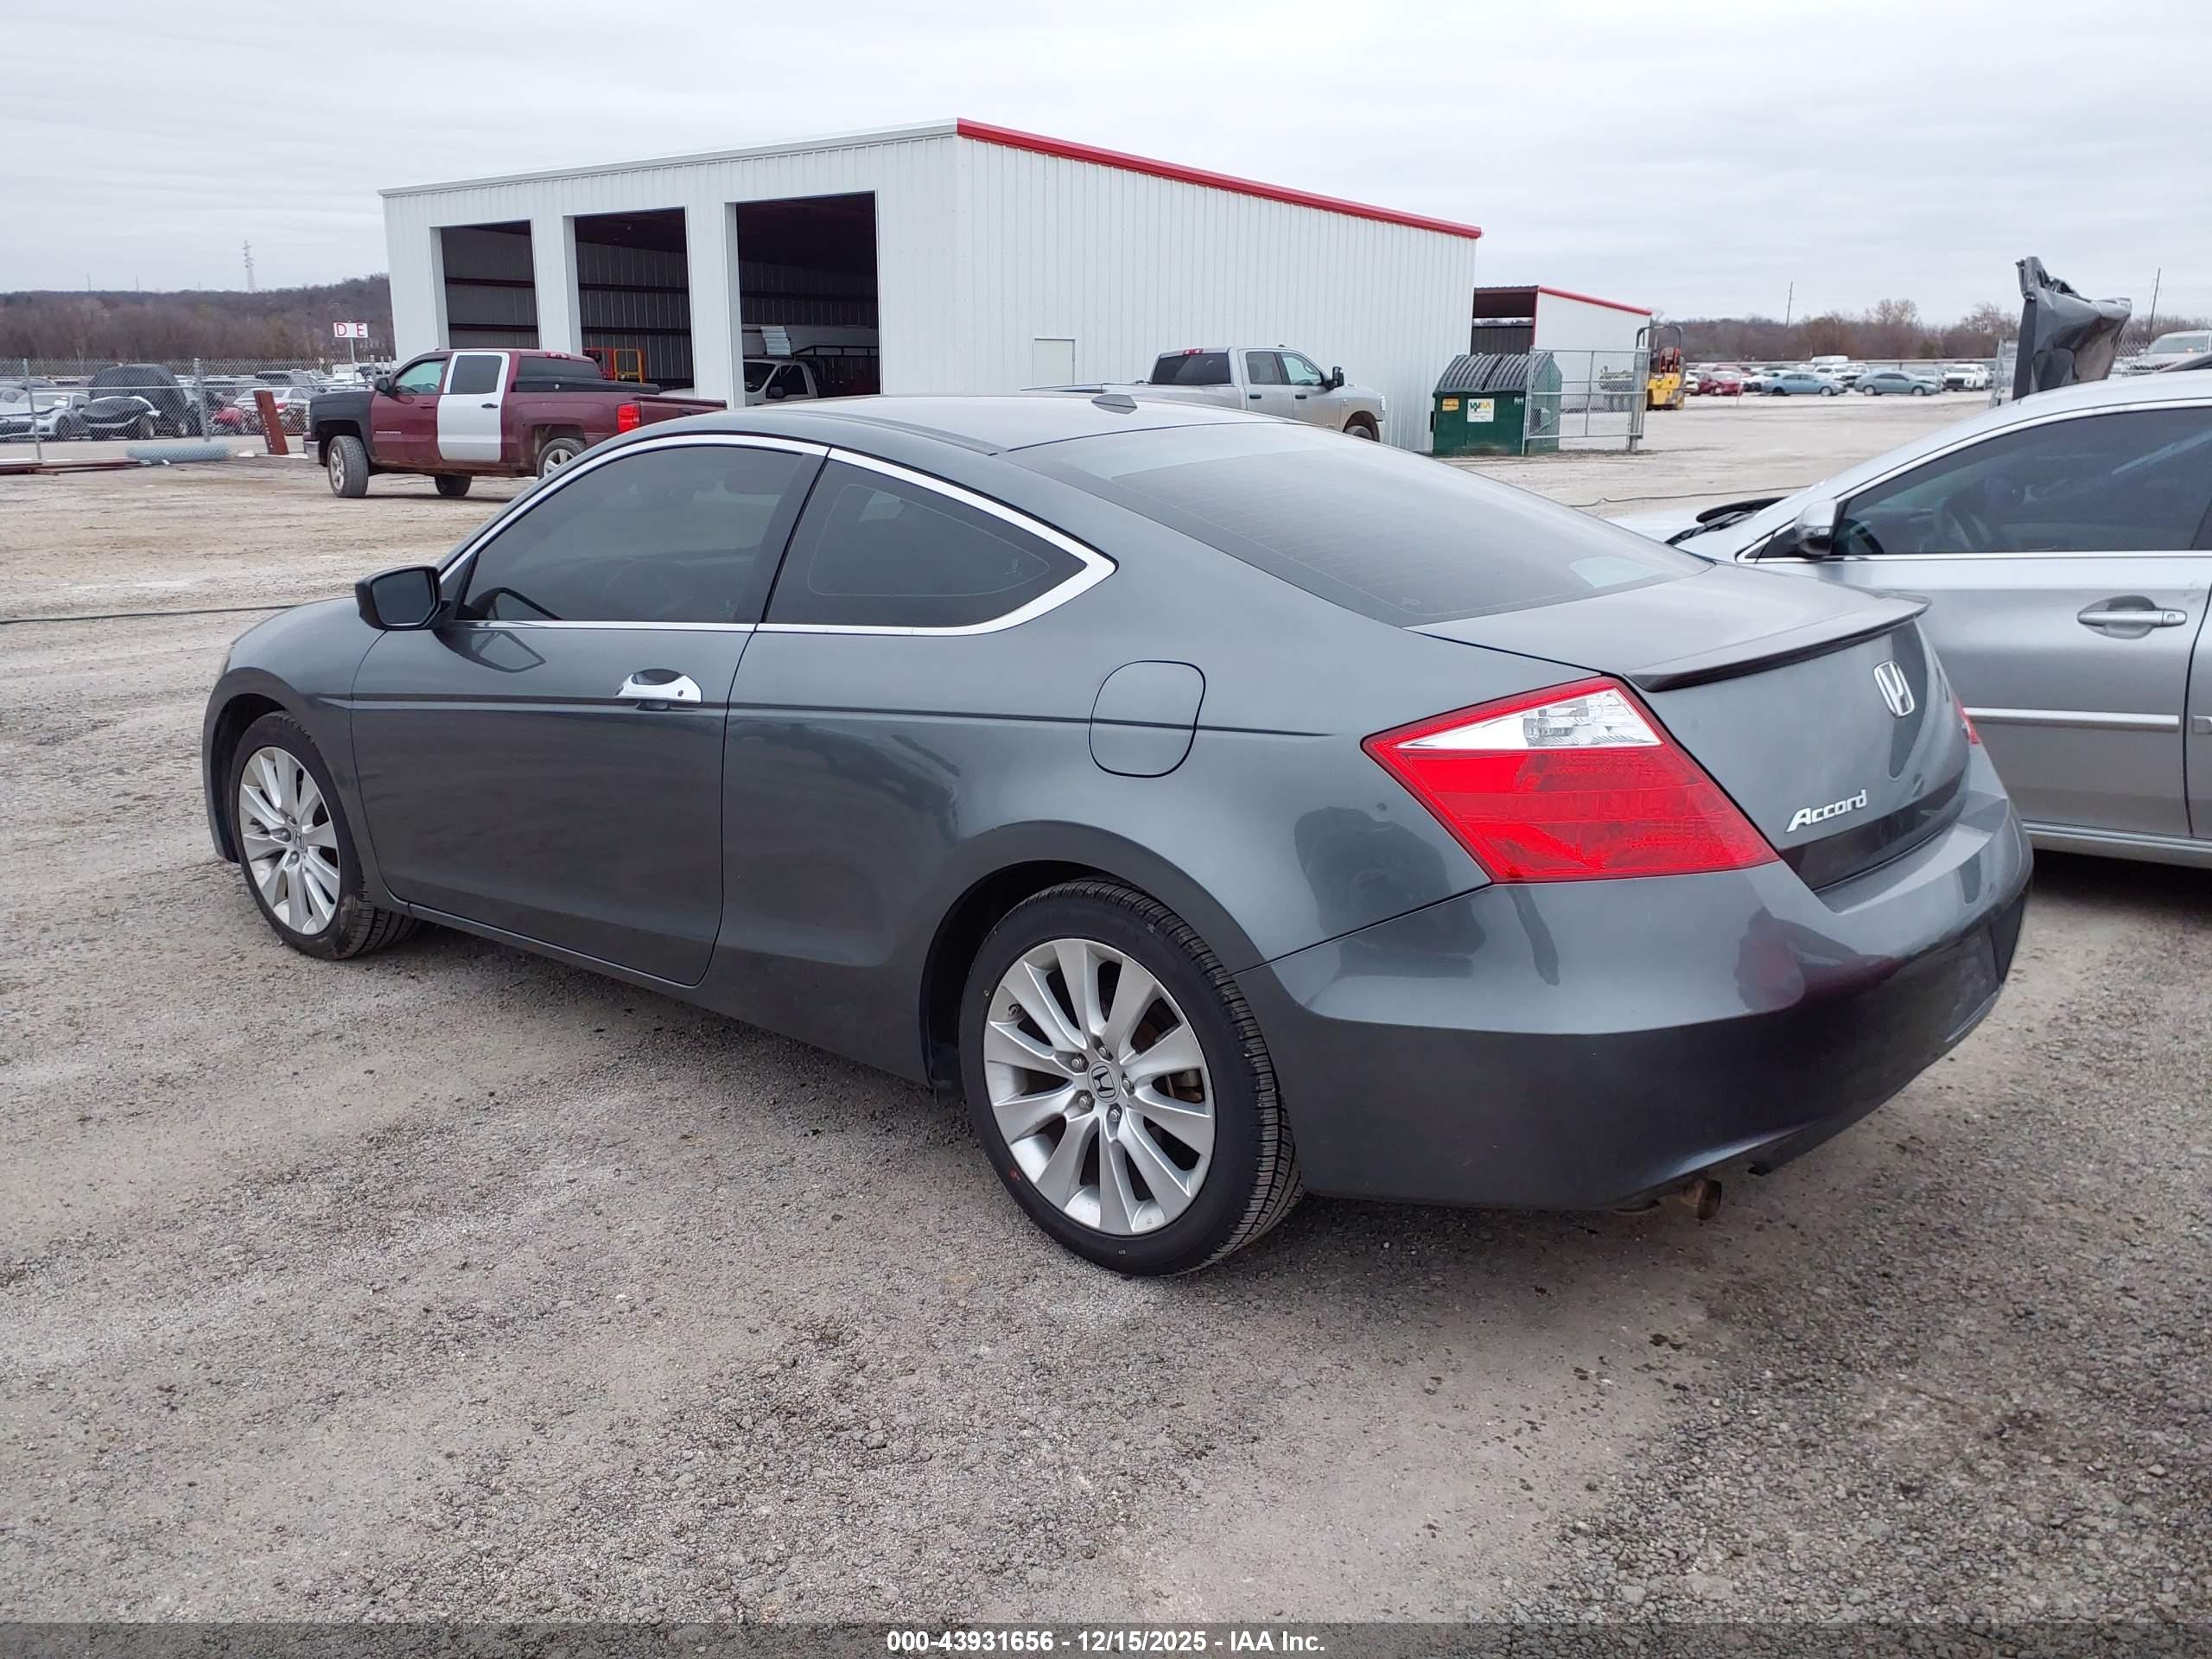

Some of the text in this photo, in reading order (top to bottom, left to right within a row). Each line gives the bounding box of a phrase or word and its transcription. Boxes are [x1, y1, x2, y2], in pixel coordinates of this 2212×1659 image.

[336, 323, 366, 336] D E
[1784, 788, 1867, 833] Accord
